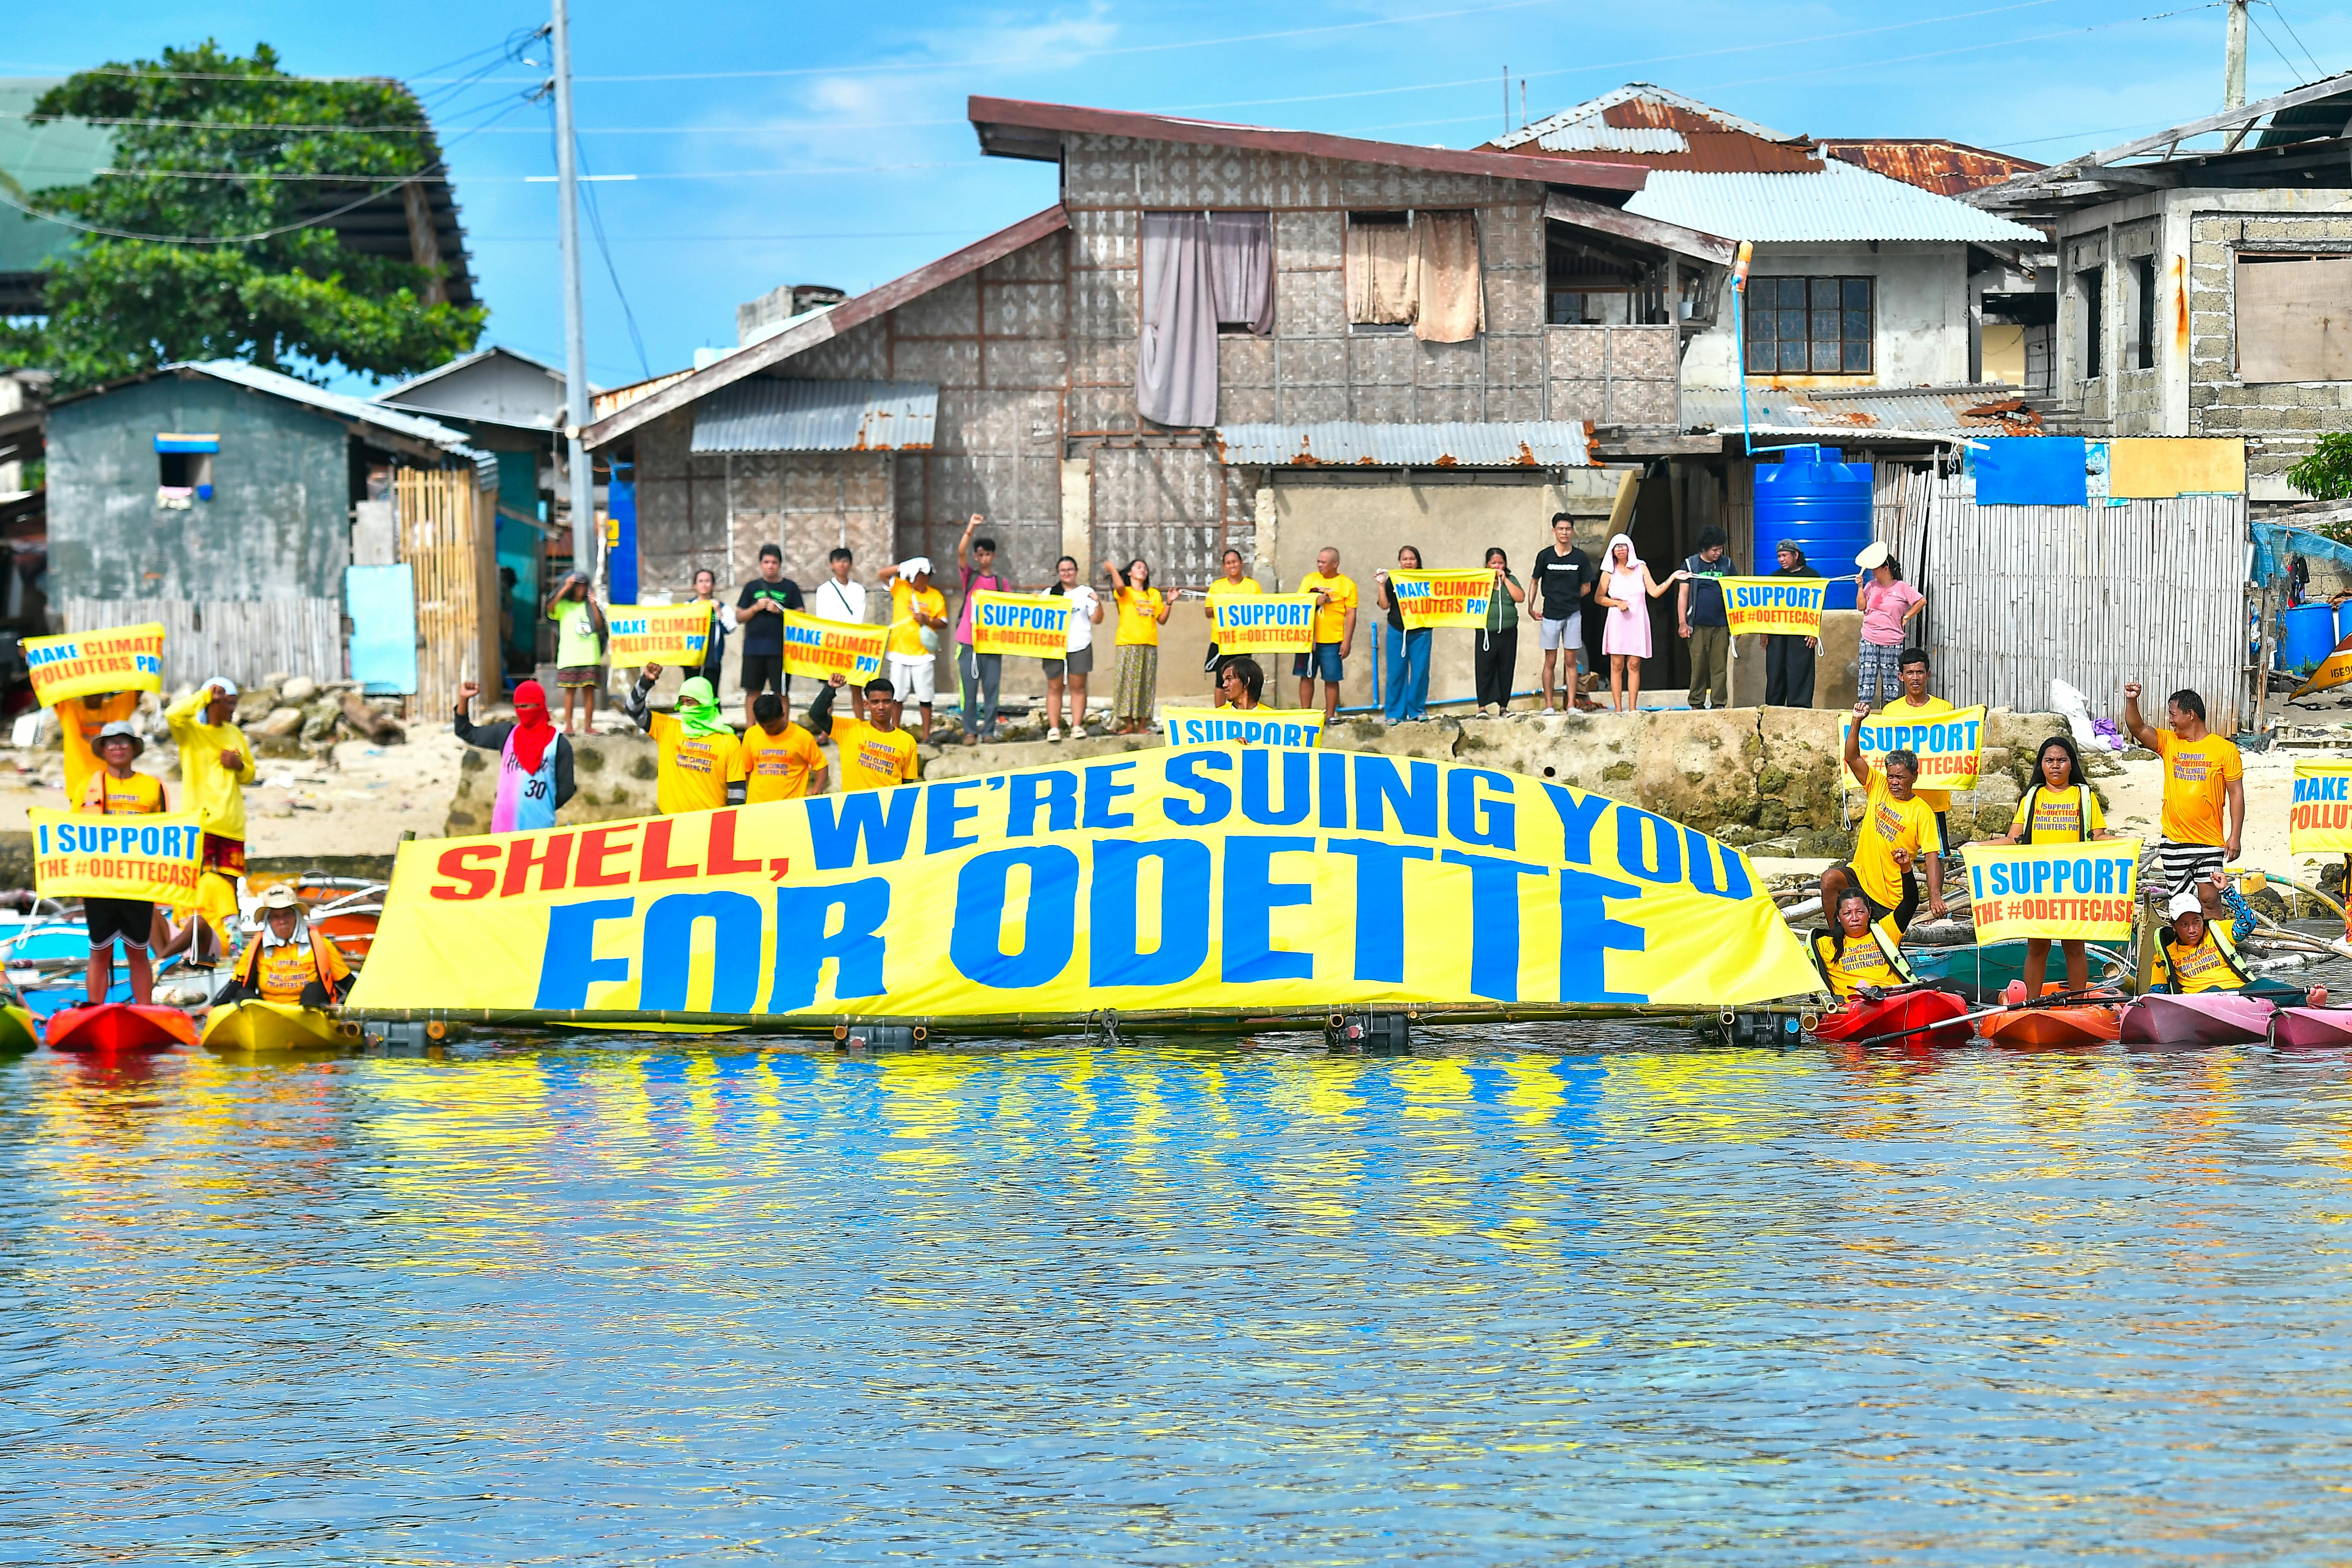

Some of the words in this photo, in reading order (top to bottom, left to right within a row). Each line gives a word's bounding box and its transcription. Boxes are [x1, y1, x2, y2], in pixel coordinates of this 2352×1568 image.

[1396, 582, 1430, 598] MAKE
[1434, 582, 1490, 597] CLIMATE
[1726, 589, 1733, 609] I
[1737, 587, 1822, 609] SUPPORT
[1218, 607, 1224, 627] I
[1228, 604, 1312, 626] SUPPORT
[1467, 599, 1487, 614] PAY
[611, 620, 646, 634] MAKE
[652, 618, 706, 632] CLIMATE
[984, 604, 1067, 631] SUPPORT
[1729, 611, 1745, 626] THE
[1748, 610, 1818, 626] #ODETTECASE
[611, 637, 682, 652] POLLUTERS
[786, 626, 821, 645] MAKE
[826, 633, 882, 655] CLIMATE
[1219, 631, 1235, 643] THE
[1240, 629, 1311, 642] #ODETTECASE
[27, 645, 79, 668] MAKE
[784, 645, 852, 668] POLLUTERS
[856, 655, 879, 672] PAY
[30, 657, 132, 689] POLLUTERS
[1169, 720, 1179, 745] I
[1186, 720, 1320, 747] SUPPORT
[1860, 721, 1979, 753] SUPPORT
[868, 741, 896, 754] SUPPORT
[1873, 755, 1978, 775] #TTECASE
[525, 779, 546, 800] 30
[2292, 777, 2349, 805] MAKE
[1881, 803, 1903, 822] SUPPORT
[431, 811, 788, 899] SHELL,
[805, 762, 1136, 870] WE'RE
[1164, 749, 1516, 850] SUING
[1541, 783, 1752, 900] YOU
[1879, 820, 1898, 837] CLIMATE
[40, 825, 48, 854] I
[57, 824, 200, 860] SUPPORT
[1886, 834, 1895, 843] PAY
[39, 859, 68, 879] THE
[75, 859, 198, 889] #ODETTECASE
[1972, 866, 1983, 899] I
[1990, 859, 2133, 895] SUPPORT
[1973, 900, 2003, 927] THE
[2007, 899, 2133, 923] #ODETTECASE
[534, 877, 890, 1014] FOR
[950, 836, 1649, 1003] ODETTE
[1841, 955, 1857, 965] MAKE
[1859, 952, 1883, 961] CLIMATE
[1843, 961, 1873, 972] POLLUTERS
[2178, 962, 2193, 972] MAKE
[2194, 953, 2218, 966] CLIMATE
[2211, 959, 2221, 968] PAY
